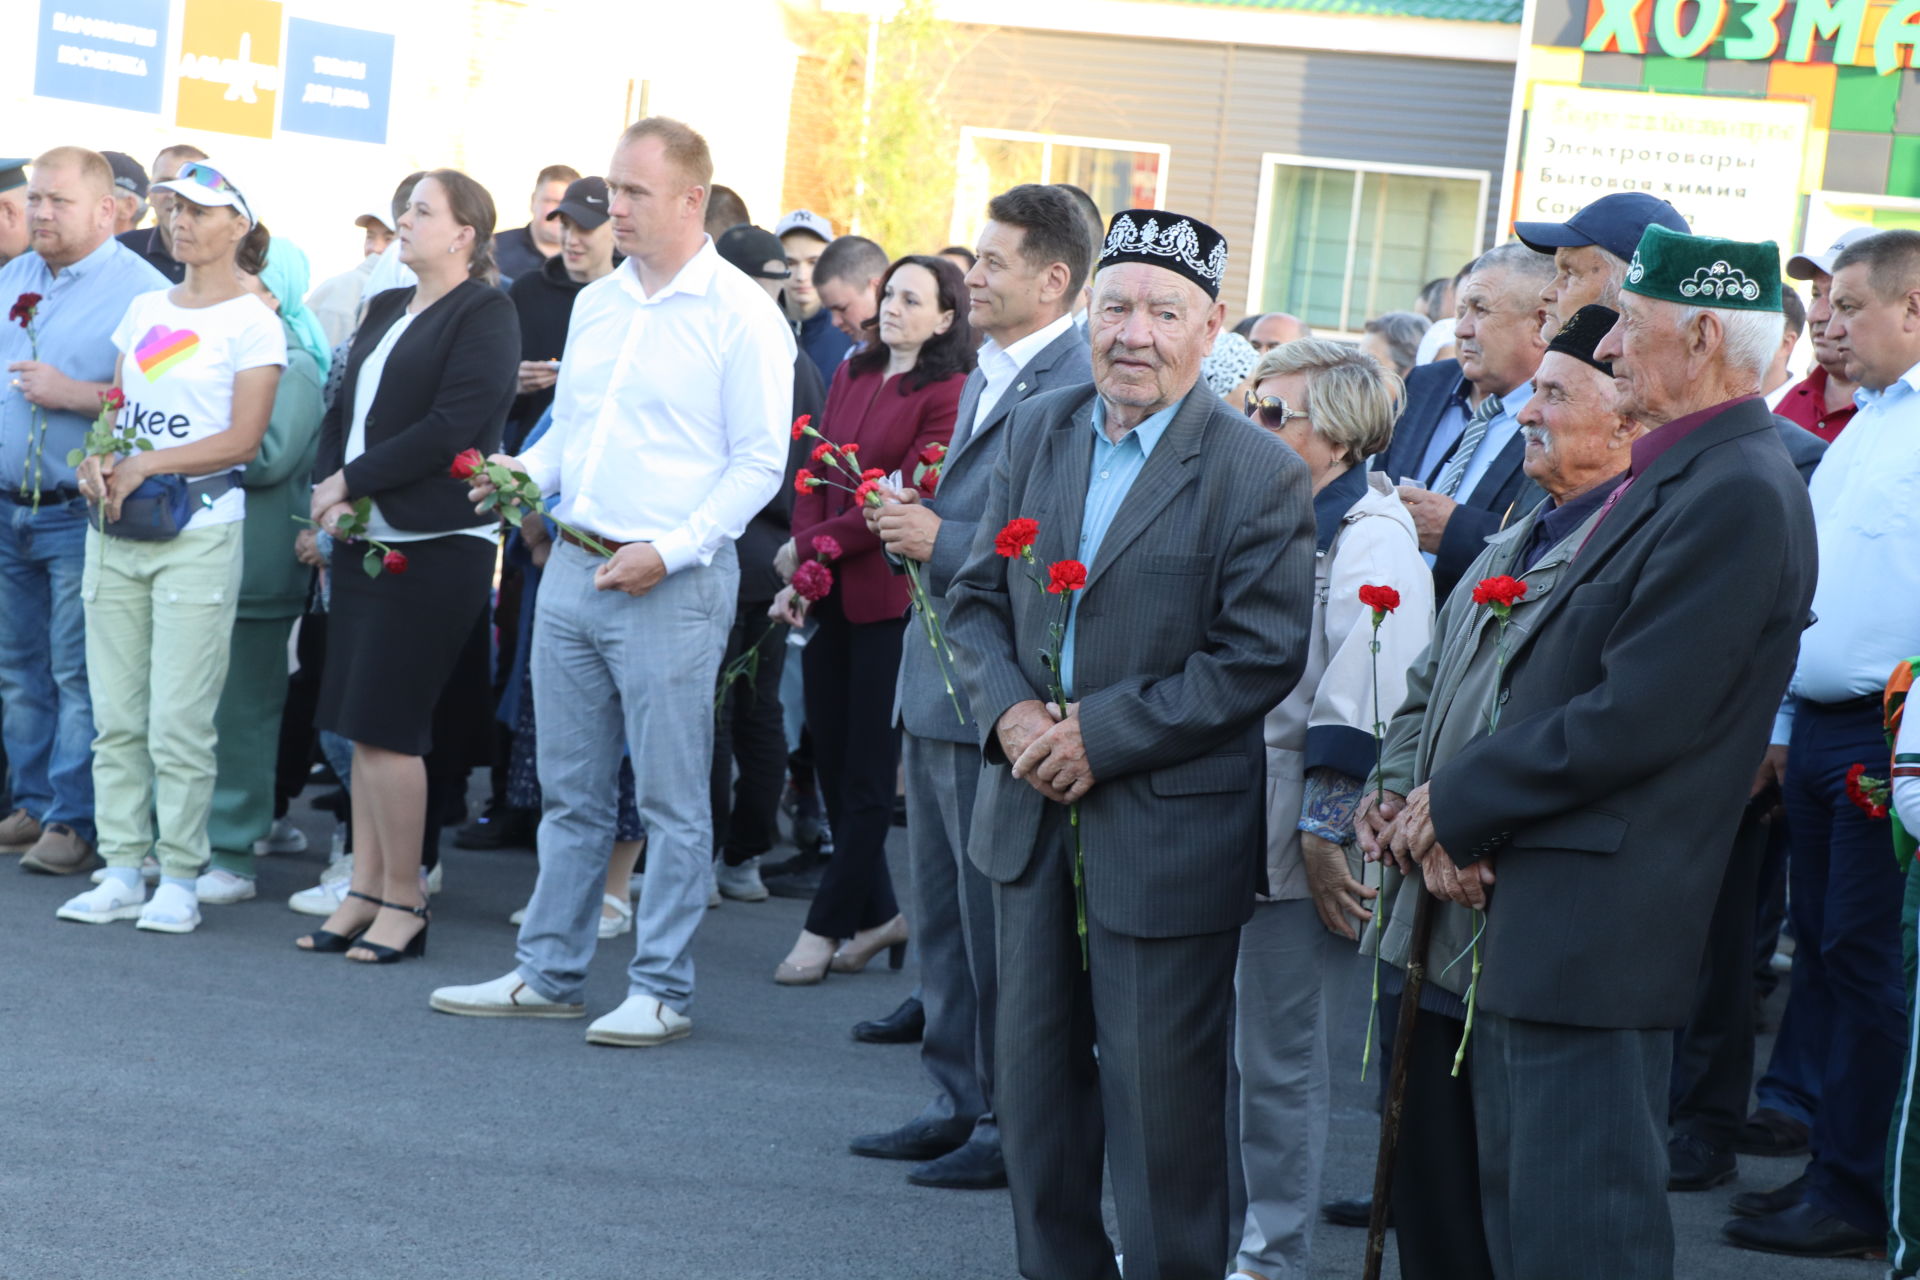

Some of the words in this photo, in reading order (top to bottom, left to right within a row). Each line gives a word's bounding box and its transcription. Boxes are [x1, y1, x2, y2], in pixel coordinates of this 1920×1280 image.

[1544, 137, 1756, 171] Электротовары
[1540, 167, 1653, 190] Бытовая
[1662, 182, 1748, 198] химия
